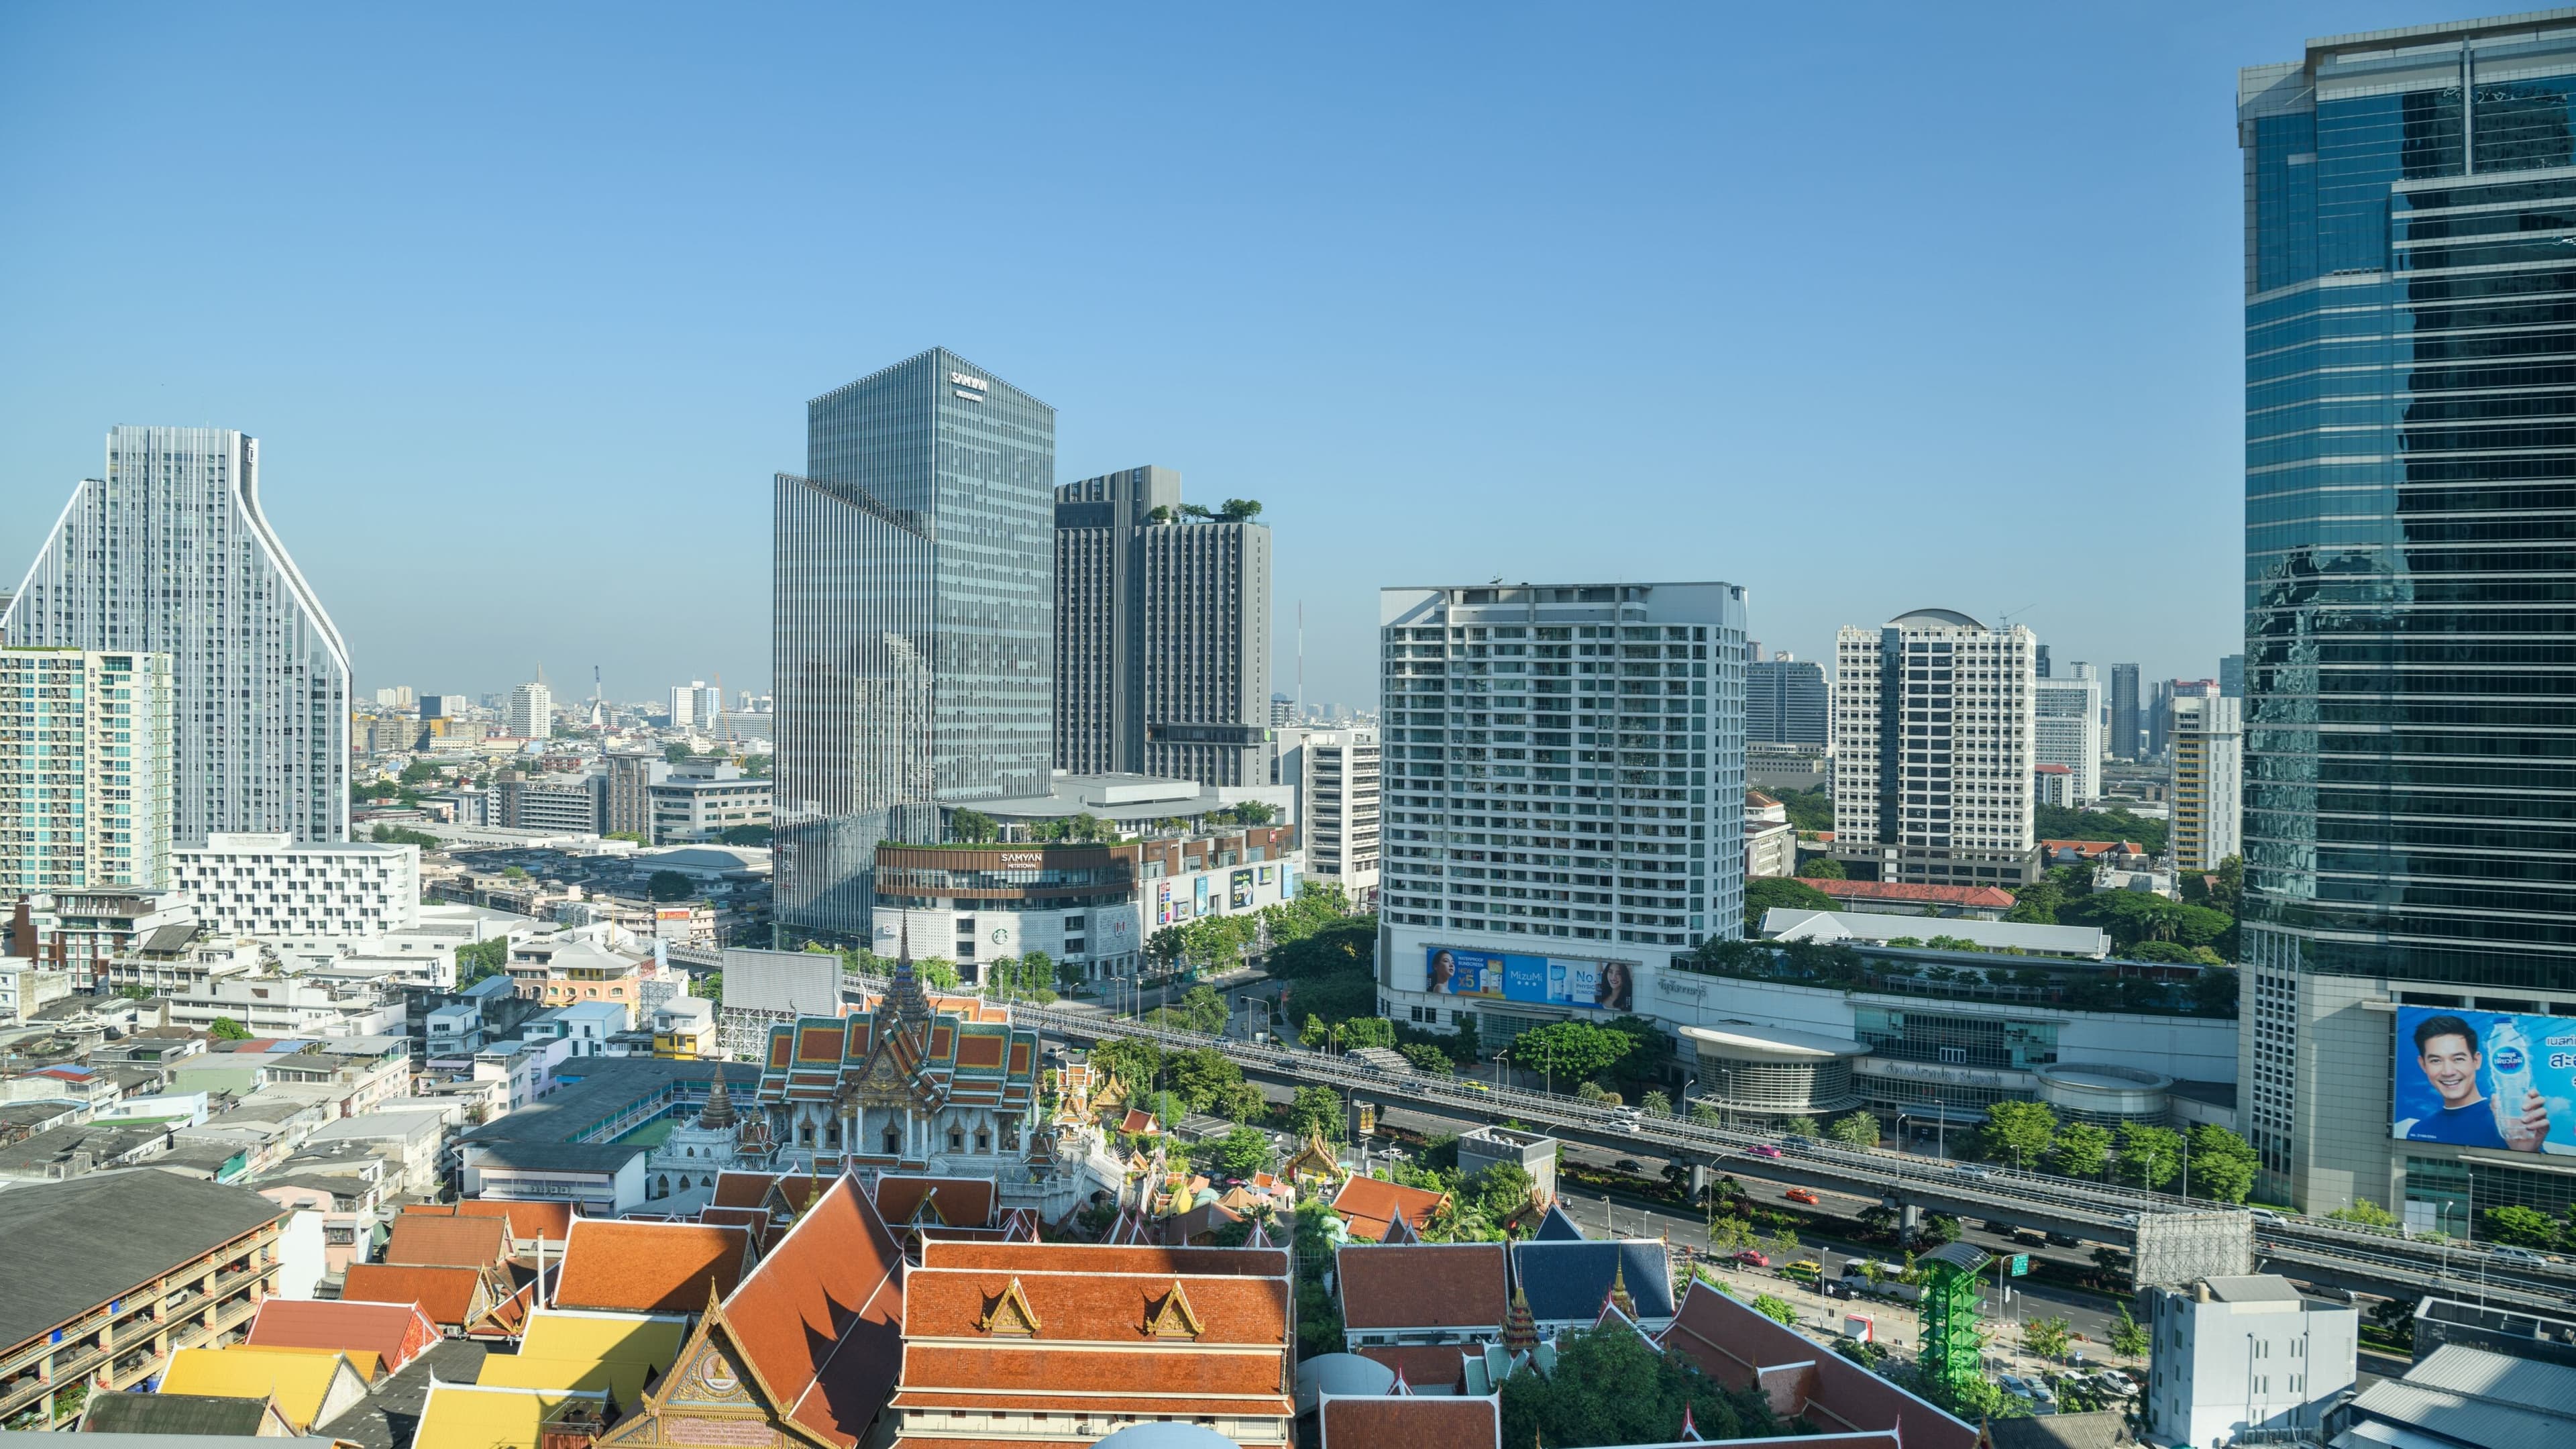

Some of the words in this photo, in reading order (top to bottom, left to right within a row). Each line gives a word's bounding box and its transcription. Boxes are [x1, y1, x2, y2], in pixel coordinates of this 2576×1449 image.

[951, 372, 987, 392] SAMYAN
[1002, 853, 1042, 861] SAMYAN
[1511, 971, 1543, 983] MizuMi
